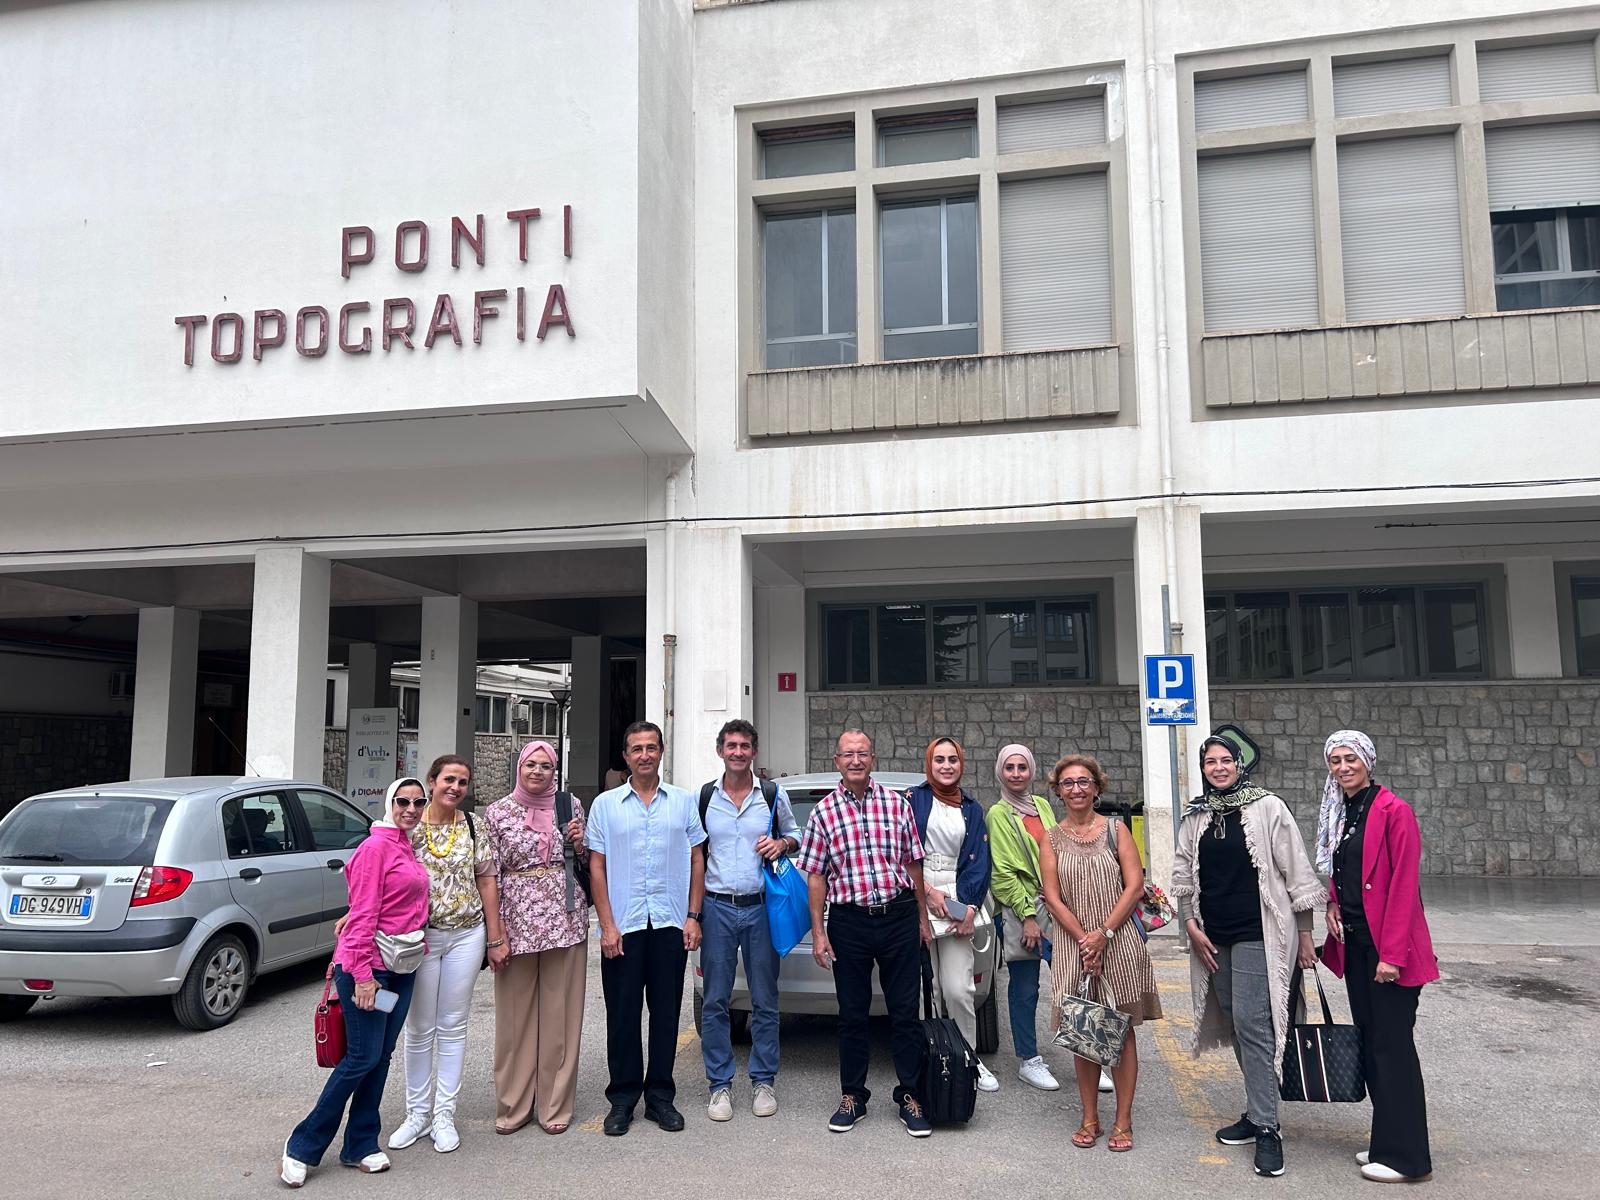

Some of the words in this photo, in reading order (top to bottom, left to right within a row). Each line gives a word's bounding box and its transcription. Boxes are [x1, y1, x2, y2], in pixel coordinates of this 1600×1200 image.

[341, 204, 573, 279] PONTI
[174, 284, 577, 366] TOPOGRAFIA
[1158, 660, 1184, 698] P
[358, 788, 384, 796] DICAM
[19, 897, 37, 913] DG
[40, 898, 83, 915] 949VH
